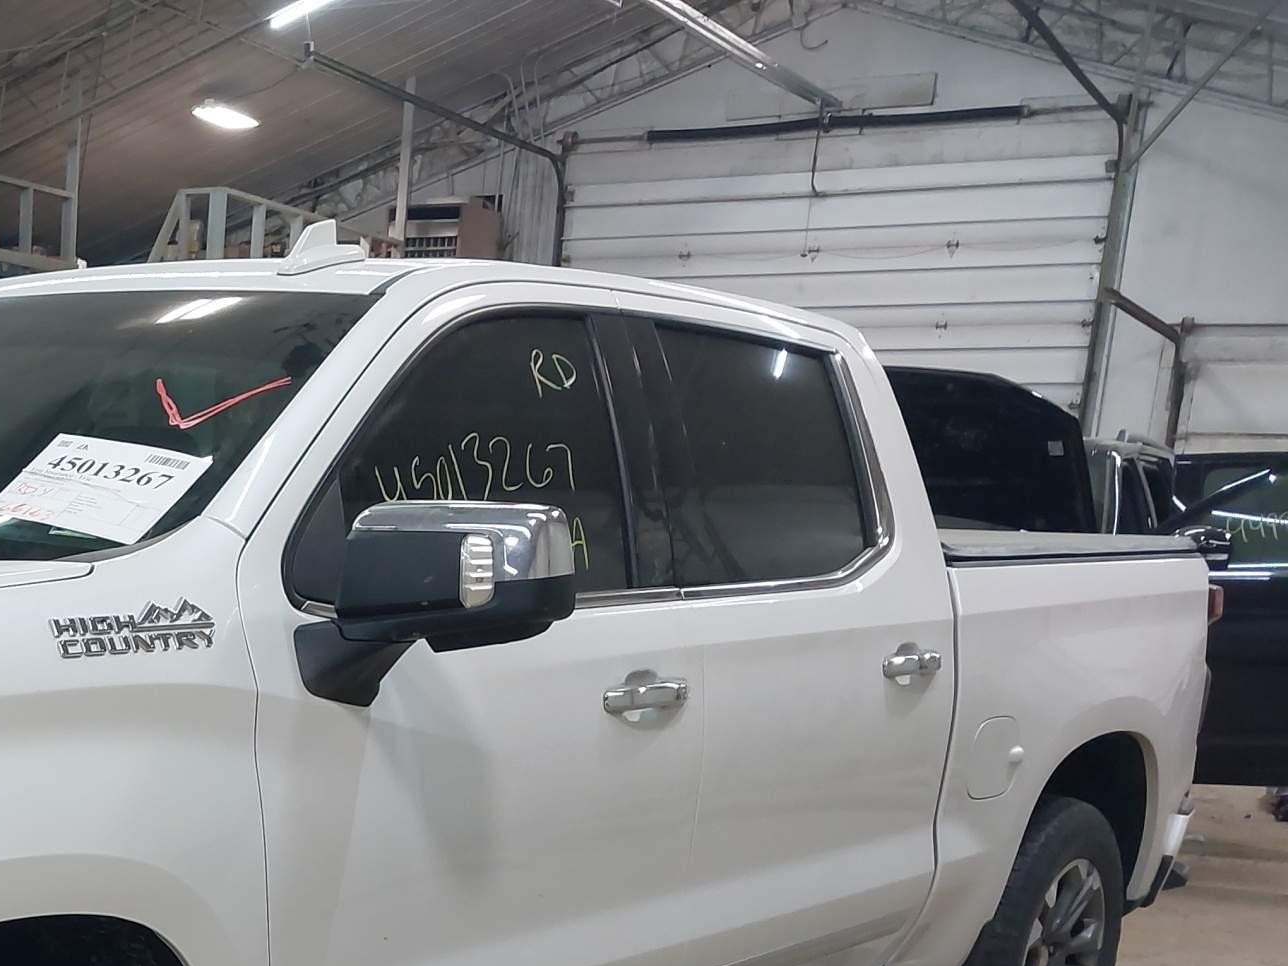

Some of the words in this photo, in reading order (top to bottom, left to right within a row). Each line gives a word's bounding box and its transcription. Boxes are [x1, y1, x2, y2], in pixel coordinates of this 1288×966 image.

[530, 349, 577, 398] RD
[48, 454, 175, 490] 45013267
[49, 615, 137, 638] HIGH
[57, 629, 215, 658] COUNTRY
